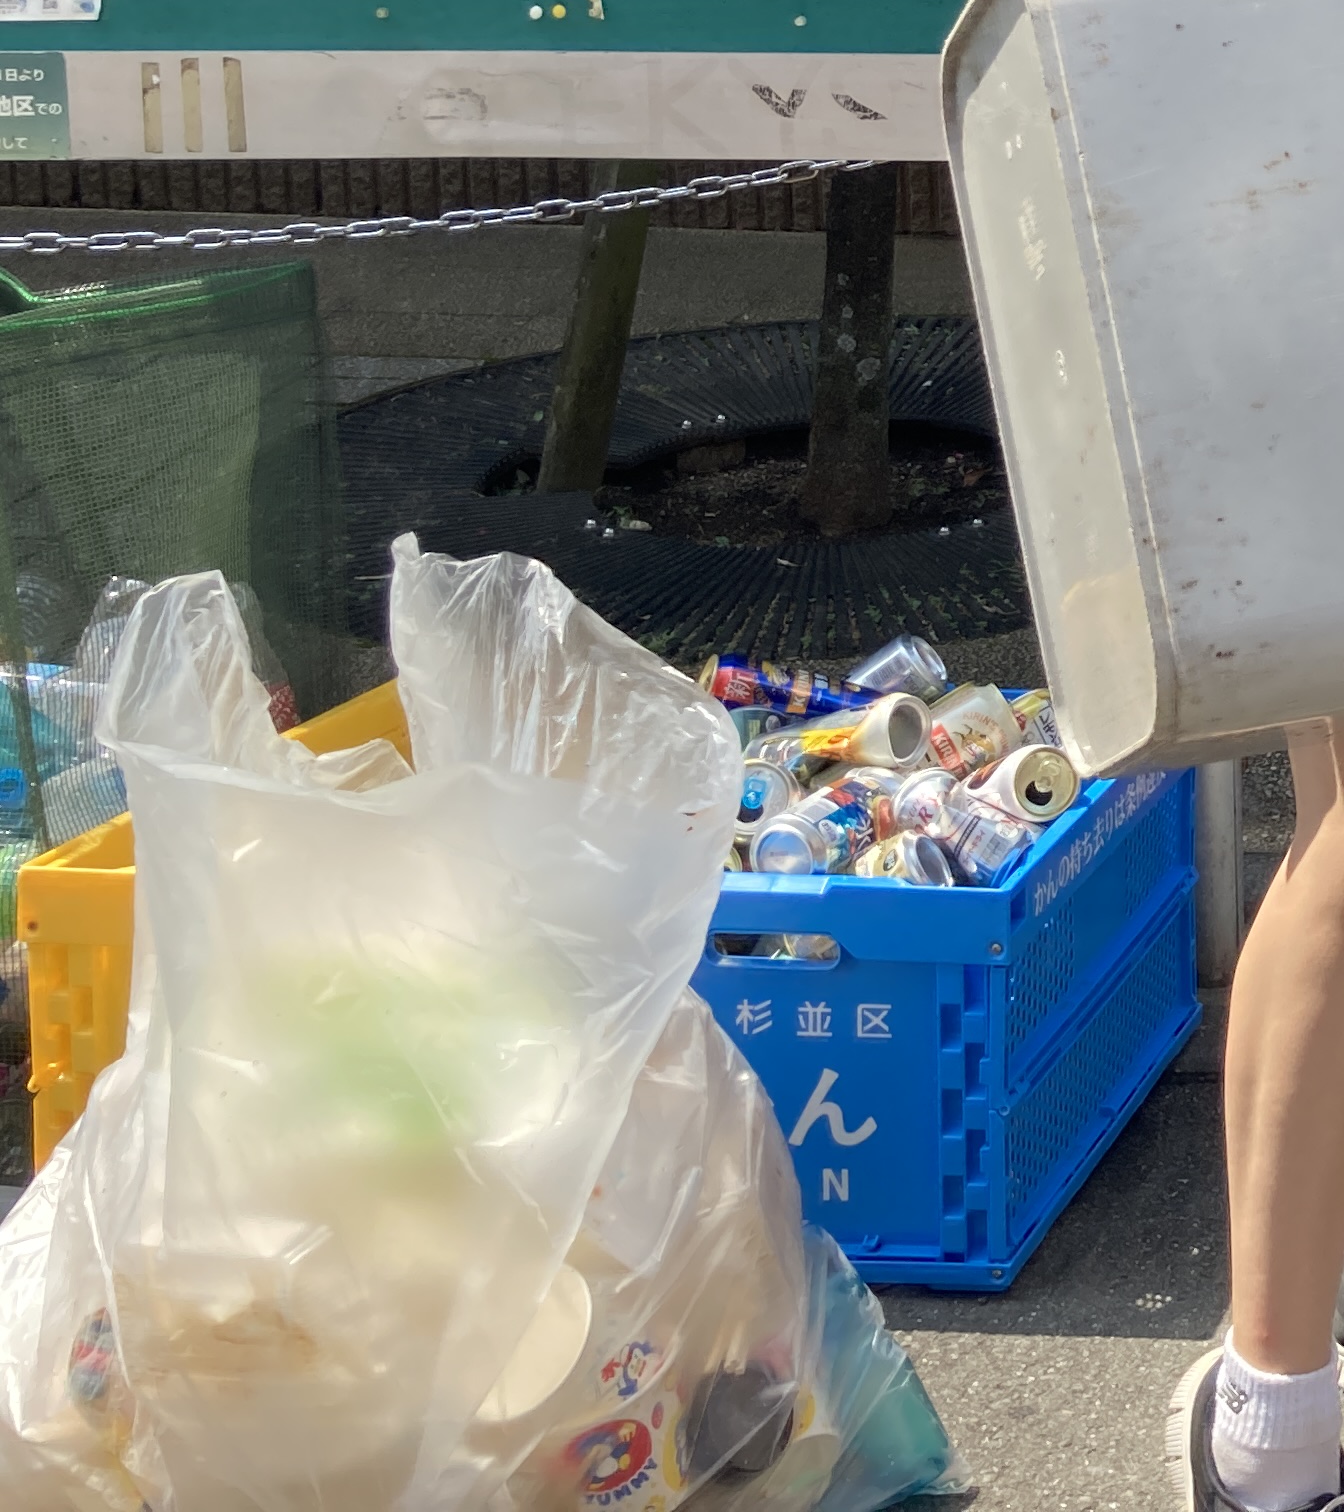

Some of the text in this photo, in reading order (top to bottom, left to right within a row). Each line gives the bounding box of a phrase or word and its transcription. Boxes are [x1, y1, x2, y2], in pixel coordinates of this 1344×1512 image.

[0, 68, 45, 82] 日より
[736, 999, 893, 1039] 杉並区
